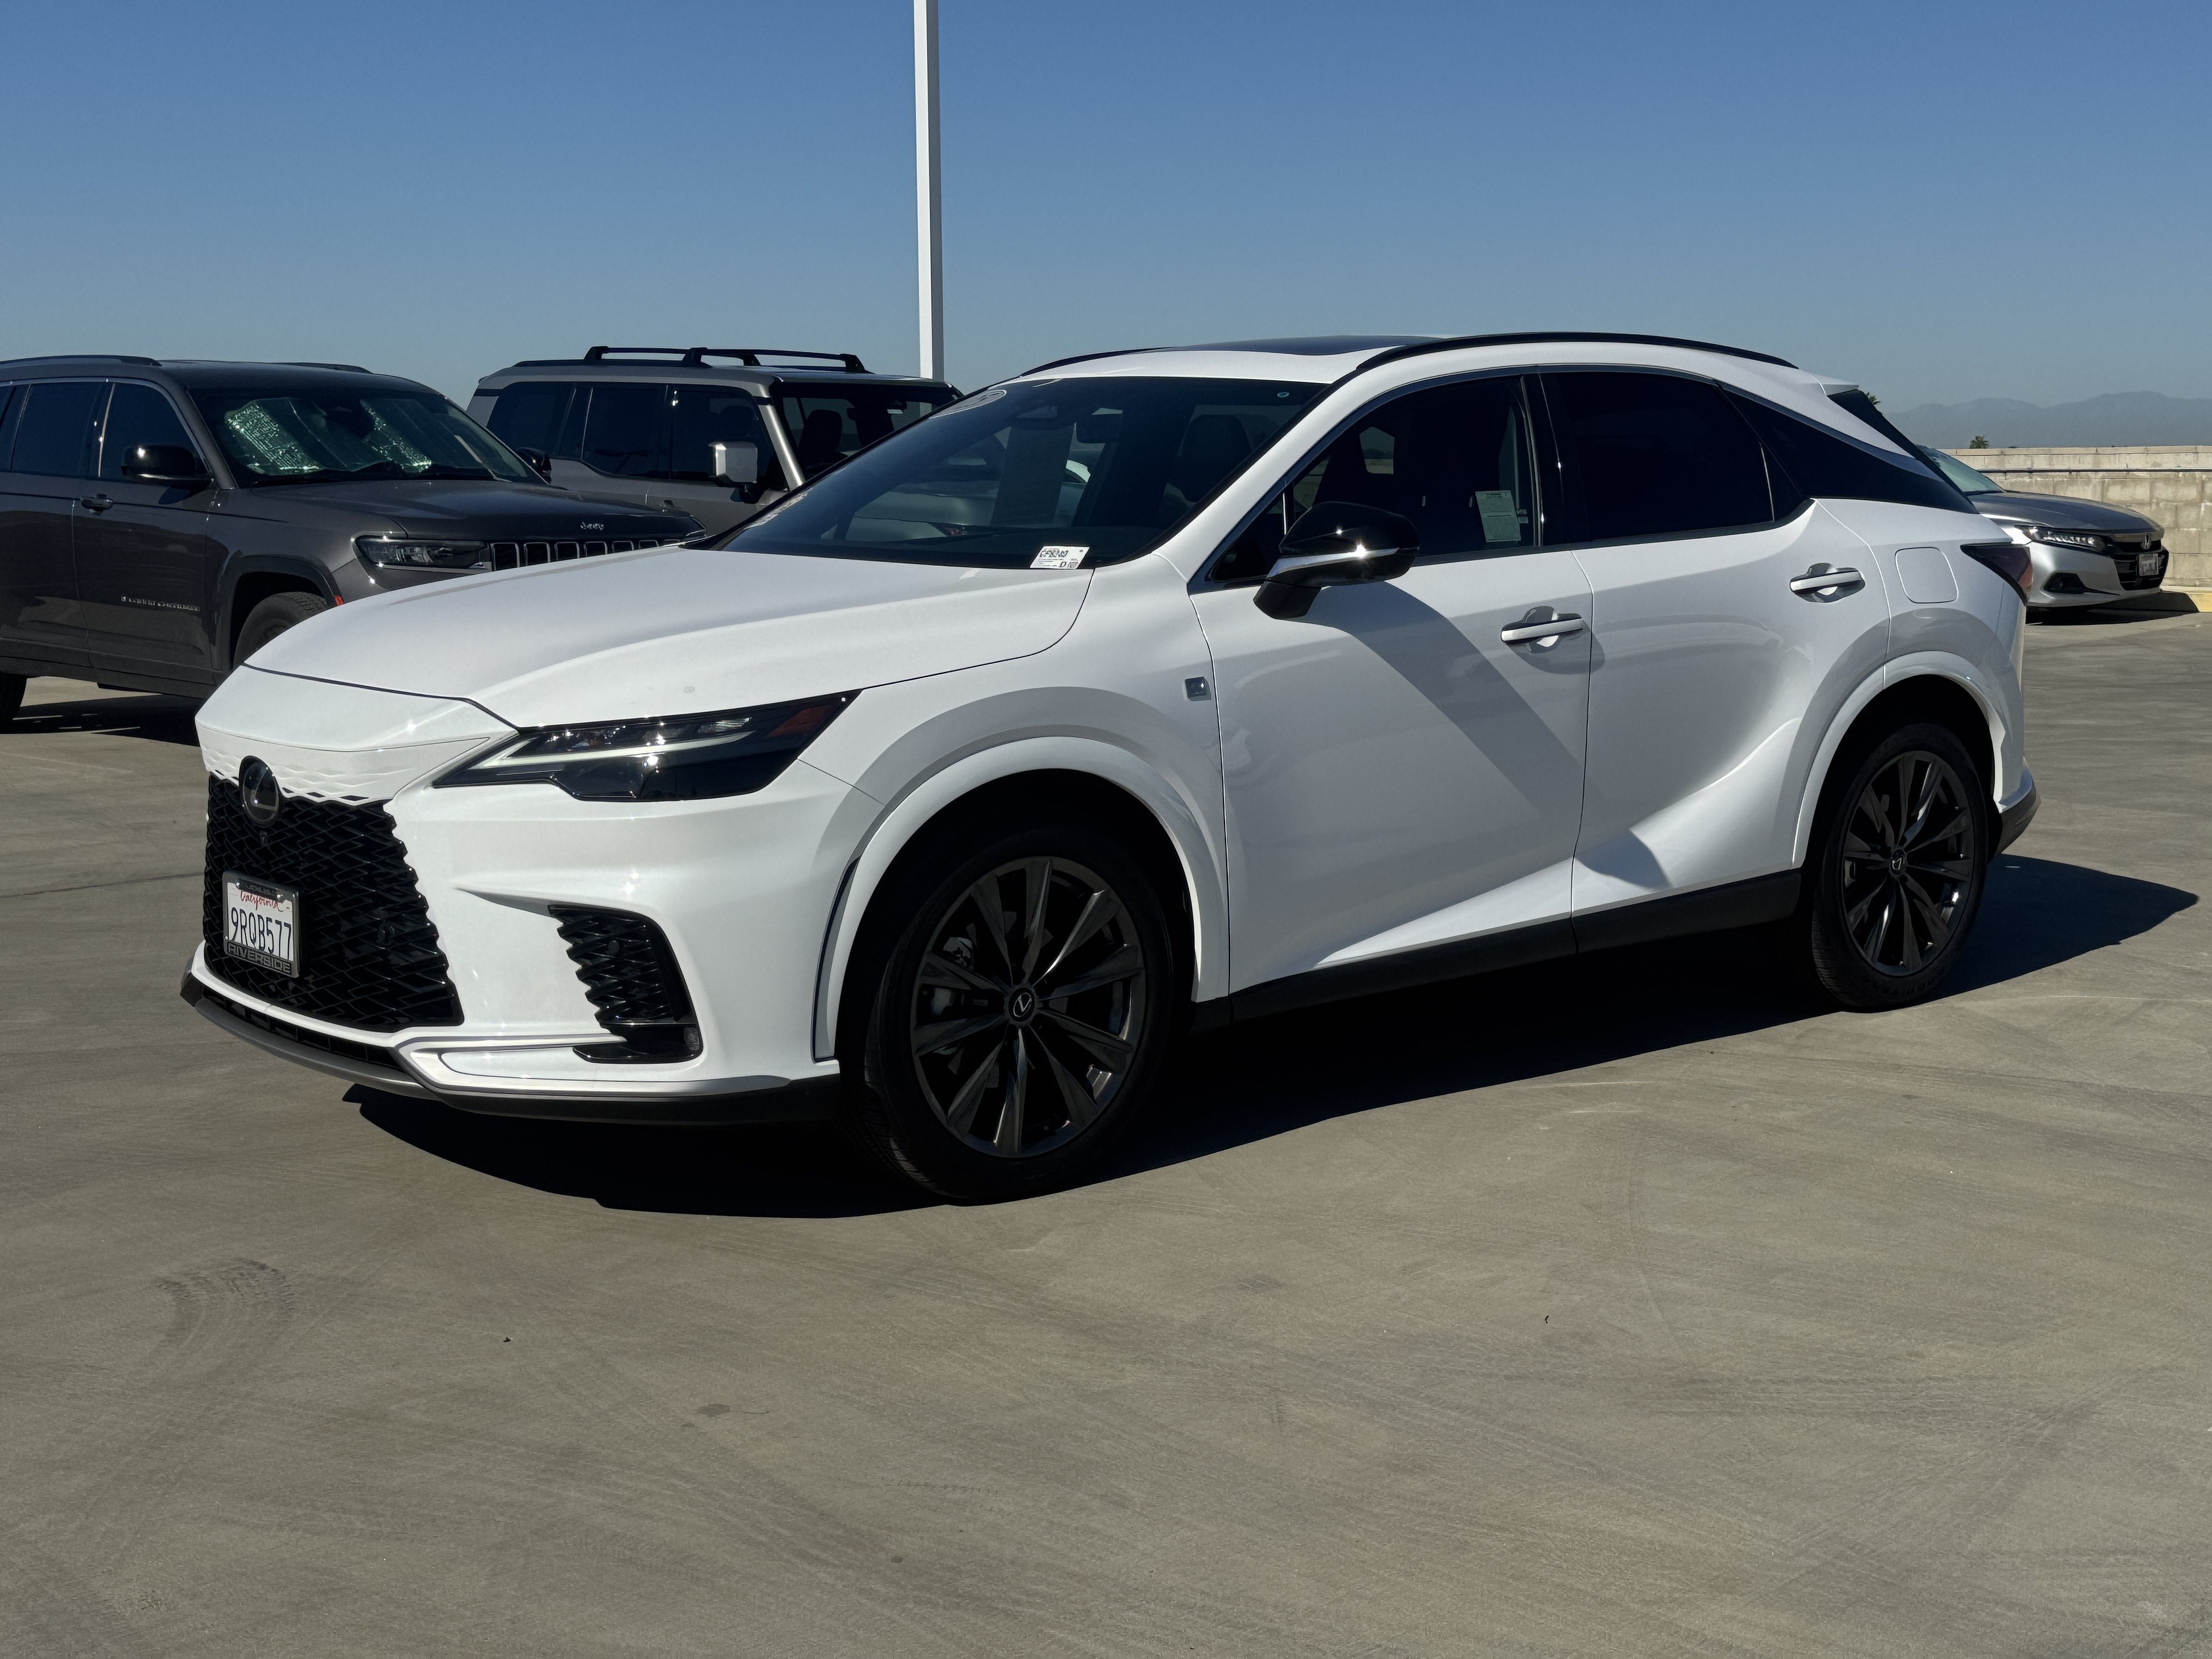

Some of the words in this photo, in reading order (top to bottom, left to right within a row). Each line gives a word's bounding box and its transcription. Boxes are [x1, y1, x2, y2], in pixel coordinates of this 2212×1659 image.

[580, 522, 605, 531] Jeep
[231, 907, 291, 960] 9RQB577
[228, 945, 291, 973] RIVERSIDE
